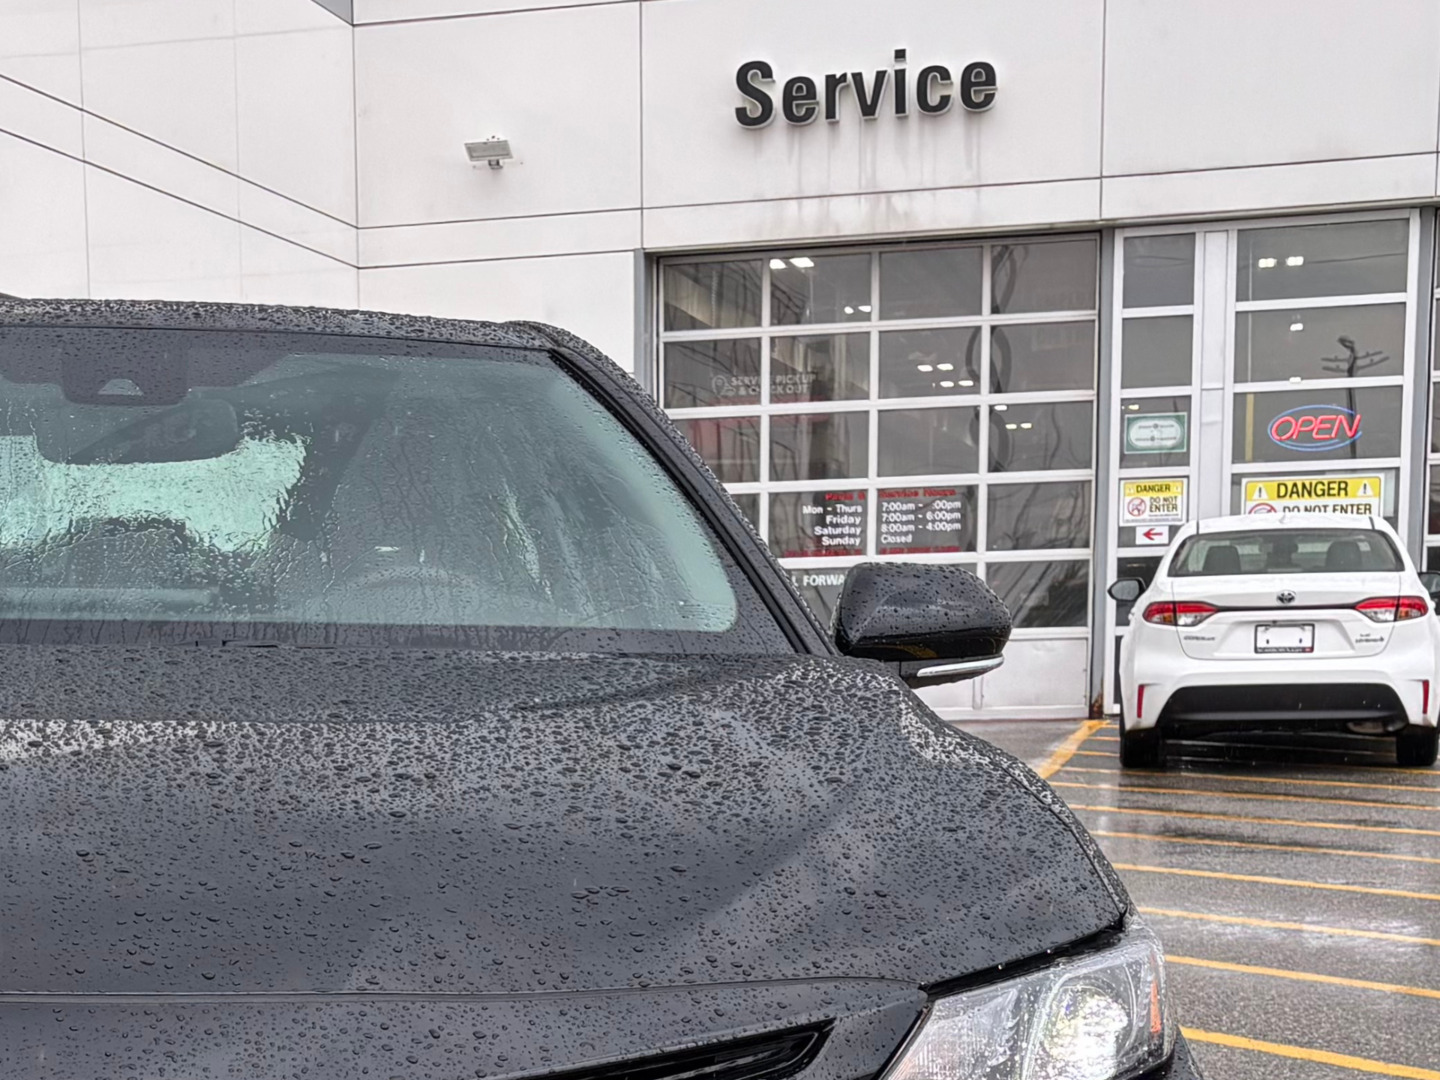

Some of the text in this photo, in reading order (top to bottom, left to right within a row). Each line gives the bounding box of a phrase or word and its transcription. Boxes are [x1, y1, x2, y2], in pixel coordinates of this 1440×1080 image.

[735, 48, 998, 128] Service
[1271, 414, 1361, 440] OPEN
[1136, 483, 1171, 493] DANGER
[1277, 480, 1349, 499] DANGER
[1150, 496, 1178, 504] DO NOT
[802, 505, 824, 514] Mon
[835, 503, 863, 513] Thurs
[881, 501, 916, 511] 7:00am
[1149, 503, 1179, 513] ENTER
[825, 515, 862, 525] Friday
[881, 513, 915, 522] 7:00am
[926, 511, 962, 521] 6:00pm
[814, 526, 862, 535] Saturday
[881, 523, 915, 533] 8:00am
[926, 521, 962, 532] 4:00pm
[822, 533, 913, 546] Sunday Closed
[803, 573, 845, 586] FORWA
